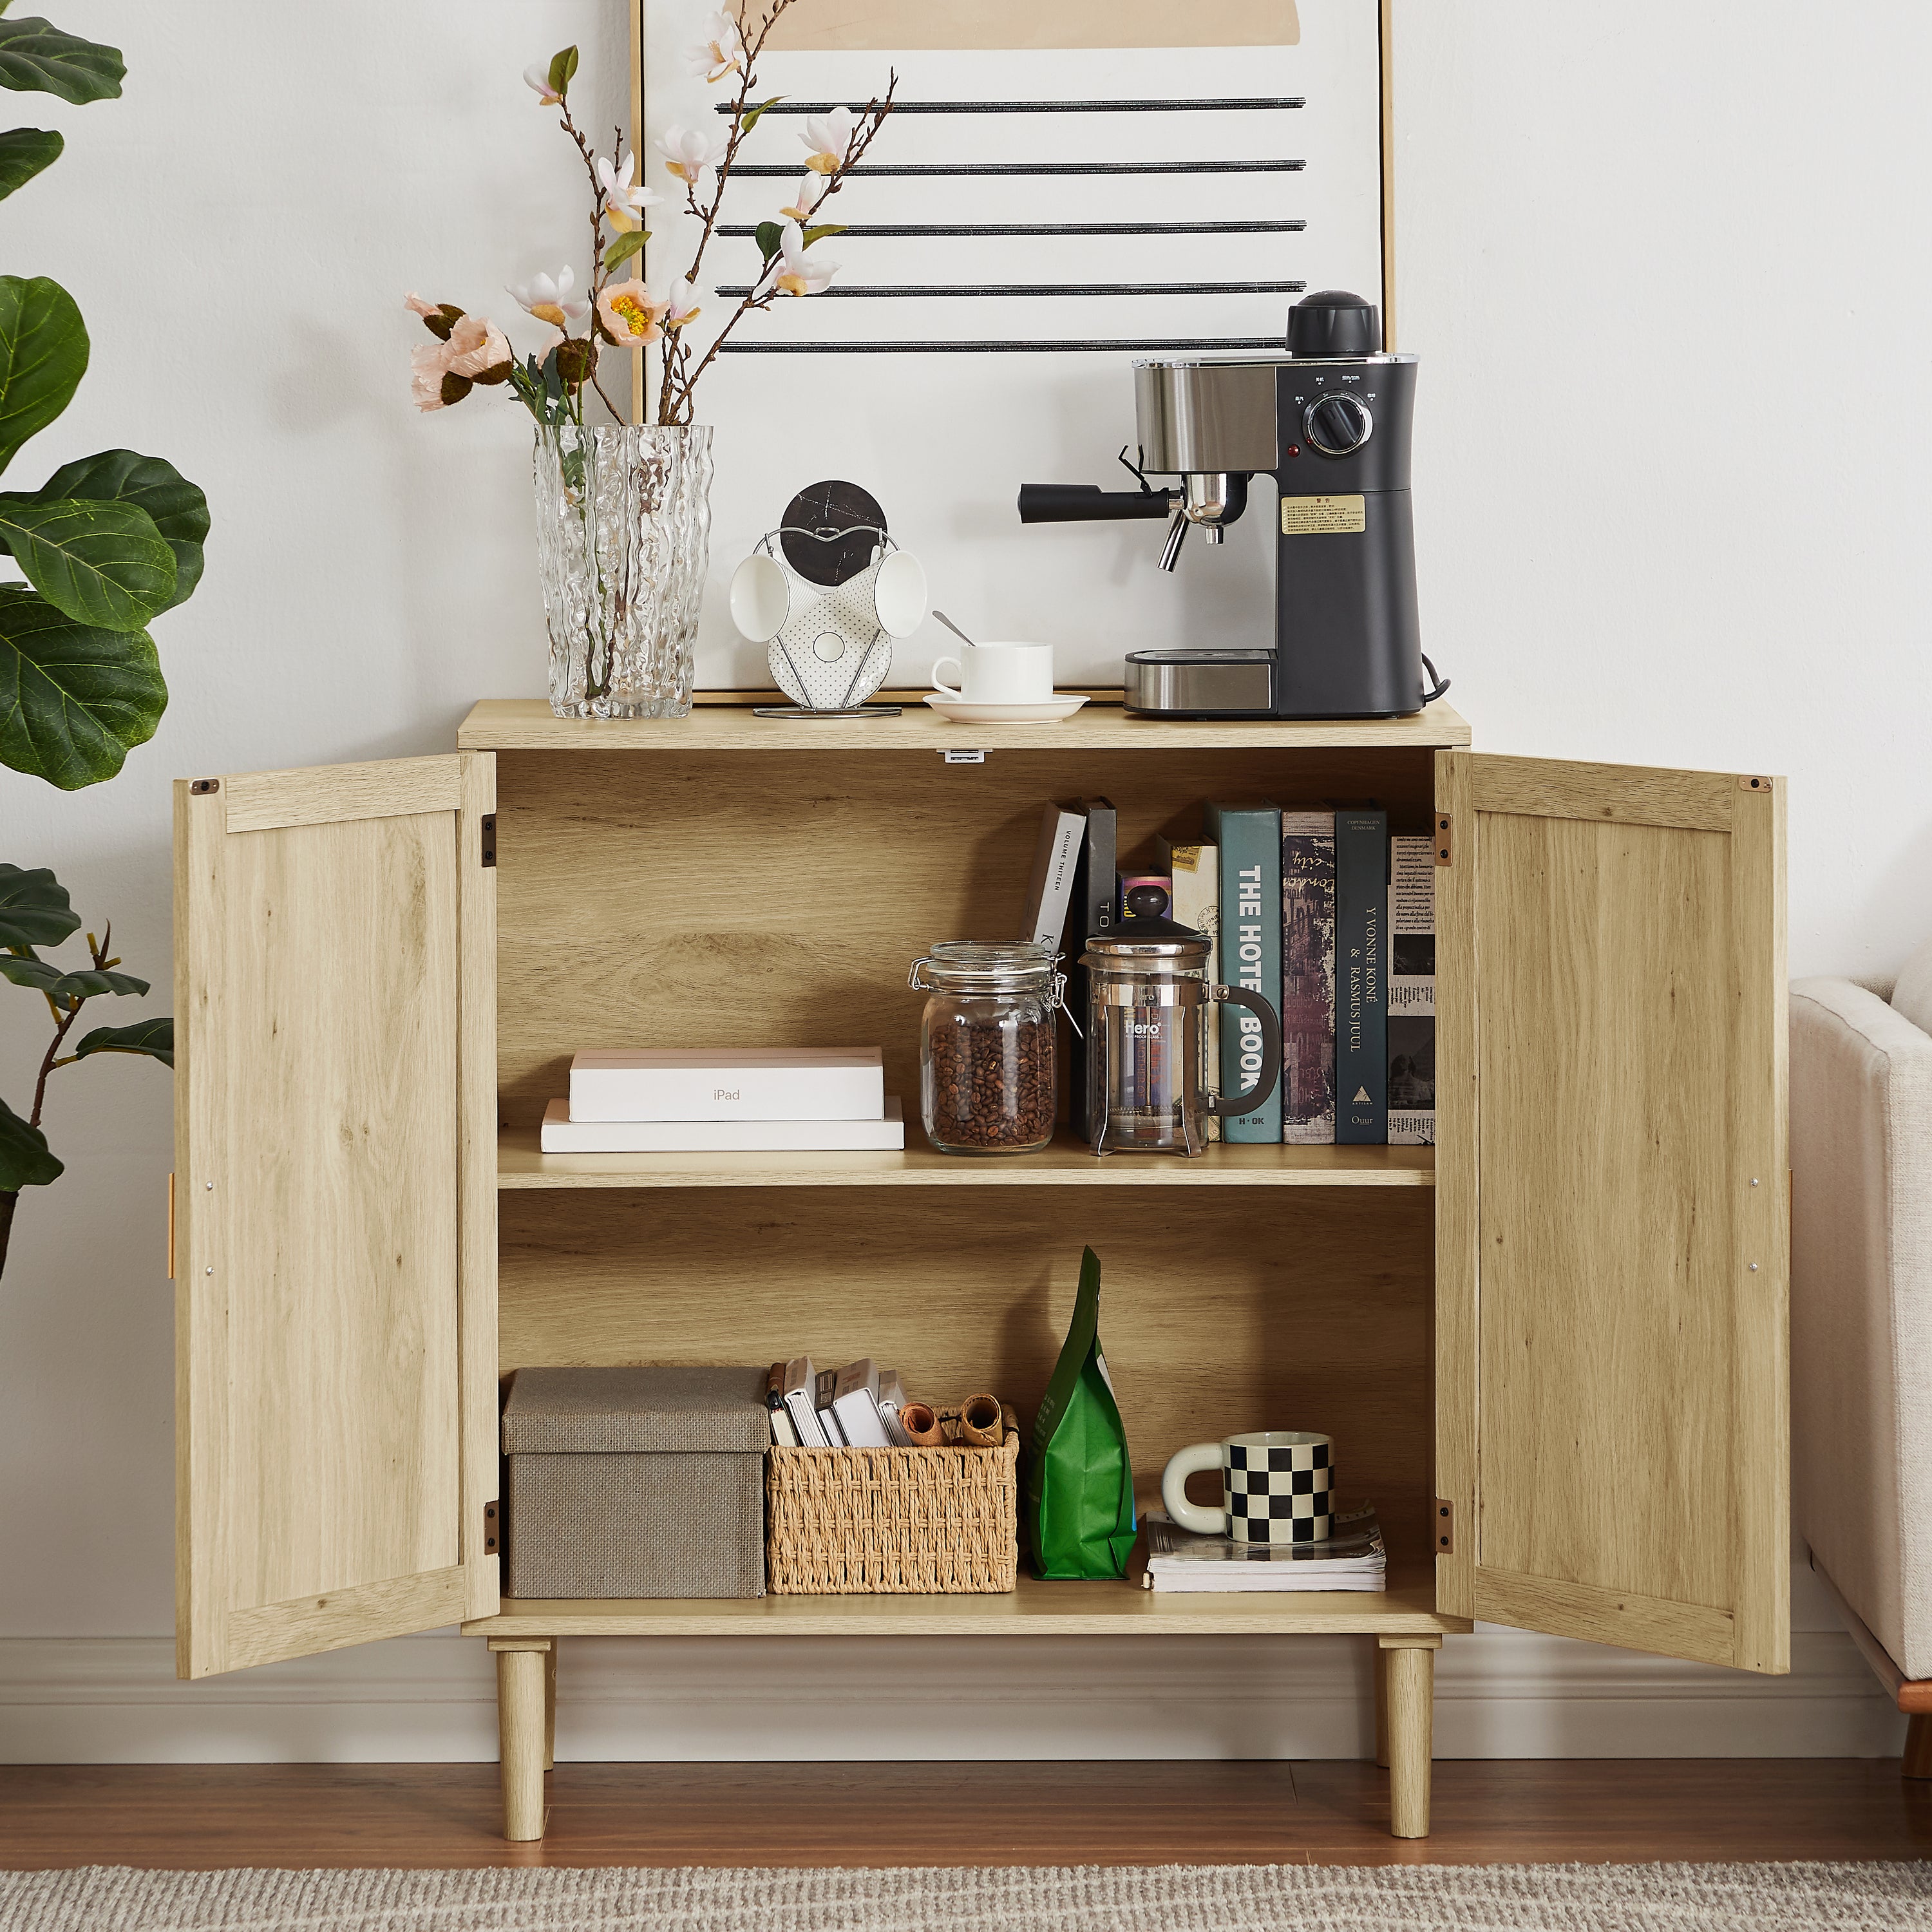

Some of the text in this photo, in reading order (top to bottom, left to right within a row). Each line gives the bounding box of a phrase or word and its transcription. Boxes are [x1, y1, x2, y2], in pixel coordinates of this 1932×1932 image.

[1054, 830, 1072, 891] VOLUME THITEEN
[1239, 865, 1262, 1090] THE HOTE BOOK
[1366, 967, 1378, 1003] KONÉ
[1349, 948, 1360, 1052] & RASMUS JUUL
[1126, 1020, 1159, 1034] Hero
[713, 1089, 740, 1101] iPad
[1351, 1115, 1373, 1125] Ouur
